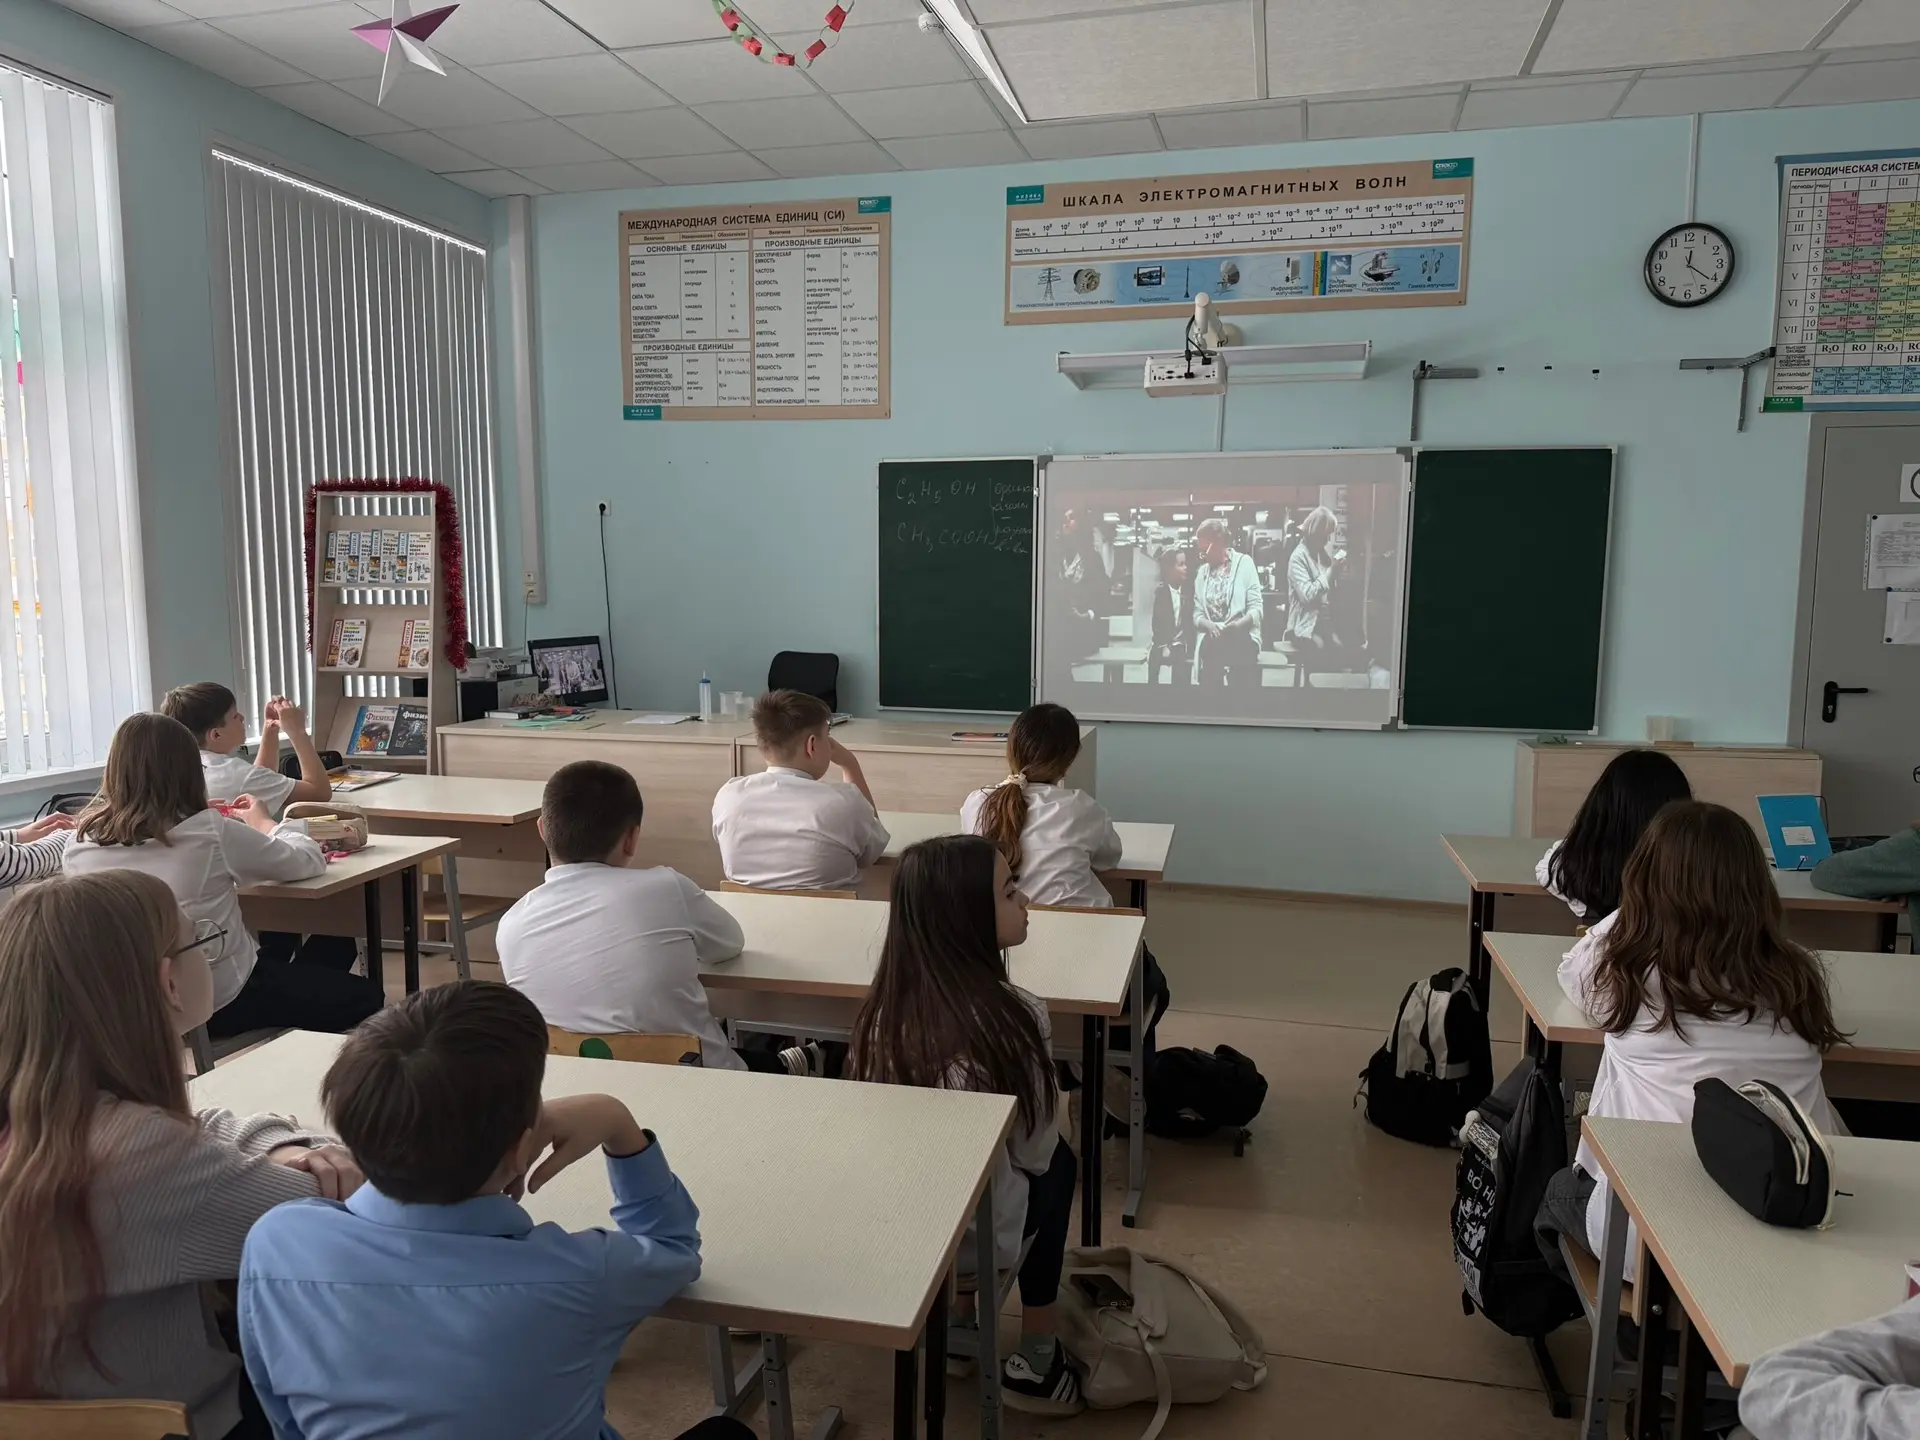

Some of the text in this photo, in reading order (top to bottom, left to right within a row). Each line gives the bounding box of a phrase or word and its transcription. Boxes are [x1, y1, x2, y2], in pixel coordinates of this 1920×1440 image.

[1791, 164, 1878, 177] ПЕРИОДИЧЕСКАЯ
[1898, 178, 1908, 186] III
[1063, 176, 1407, 207] ШКАЛА ЭЛЕКТРОМАГНИТНЫХ ВОЛН
[1797, 210, 1803, 218] II
[628, 210, 845, 231] МЕЖДУНАРОДНАЯ СИСТЕМА ЕДИНИЦ (СИ)
[1794, 224, 1804, 232] III
[1816, 223, 1821, 231] 3
[1684, 232, 1695, 242] 12
[1703, 235, 1706, 244] 1
[1815, 237, 1820, 245] 4
[765, 237, 861, 247] ПРОИЗВОДНЫЕ ЕДИНИЦЫ
[1670, 238, 1677, 248] 11
[646, 243, 727, 253] ОСНОВНЫЕ ЕДИНИЦЫ
[1712, 245, 1720, 255] 2
[1792, 244, 1803, 252] IV
[1659, 250, 1668, 260] 10
[1654, 263, 1662, 273] 9
[1716, 258, 1724, 269] 3
[1658, 276, 1666, 286] 8
[1711, 272, 1718, 282] 4
[1812, 278, 1817, 286] 7
[1669, 287, 1676, 296] 7
[1700, 284, 1707, 294] 5
[1684, 289, 1691, 299] 6
[1810, 292, 1816, 300] 8
[1788, 299, 1798, 307] VI
[1809, 306, 1814, 314] 9
[1806, 319, 1816, 328] 10
[1784, 326, 1798, 334] VII
[698, 343, 734, 351] ЕДИНИЦЫ
[378, 741, 384, 749] 9
